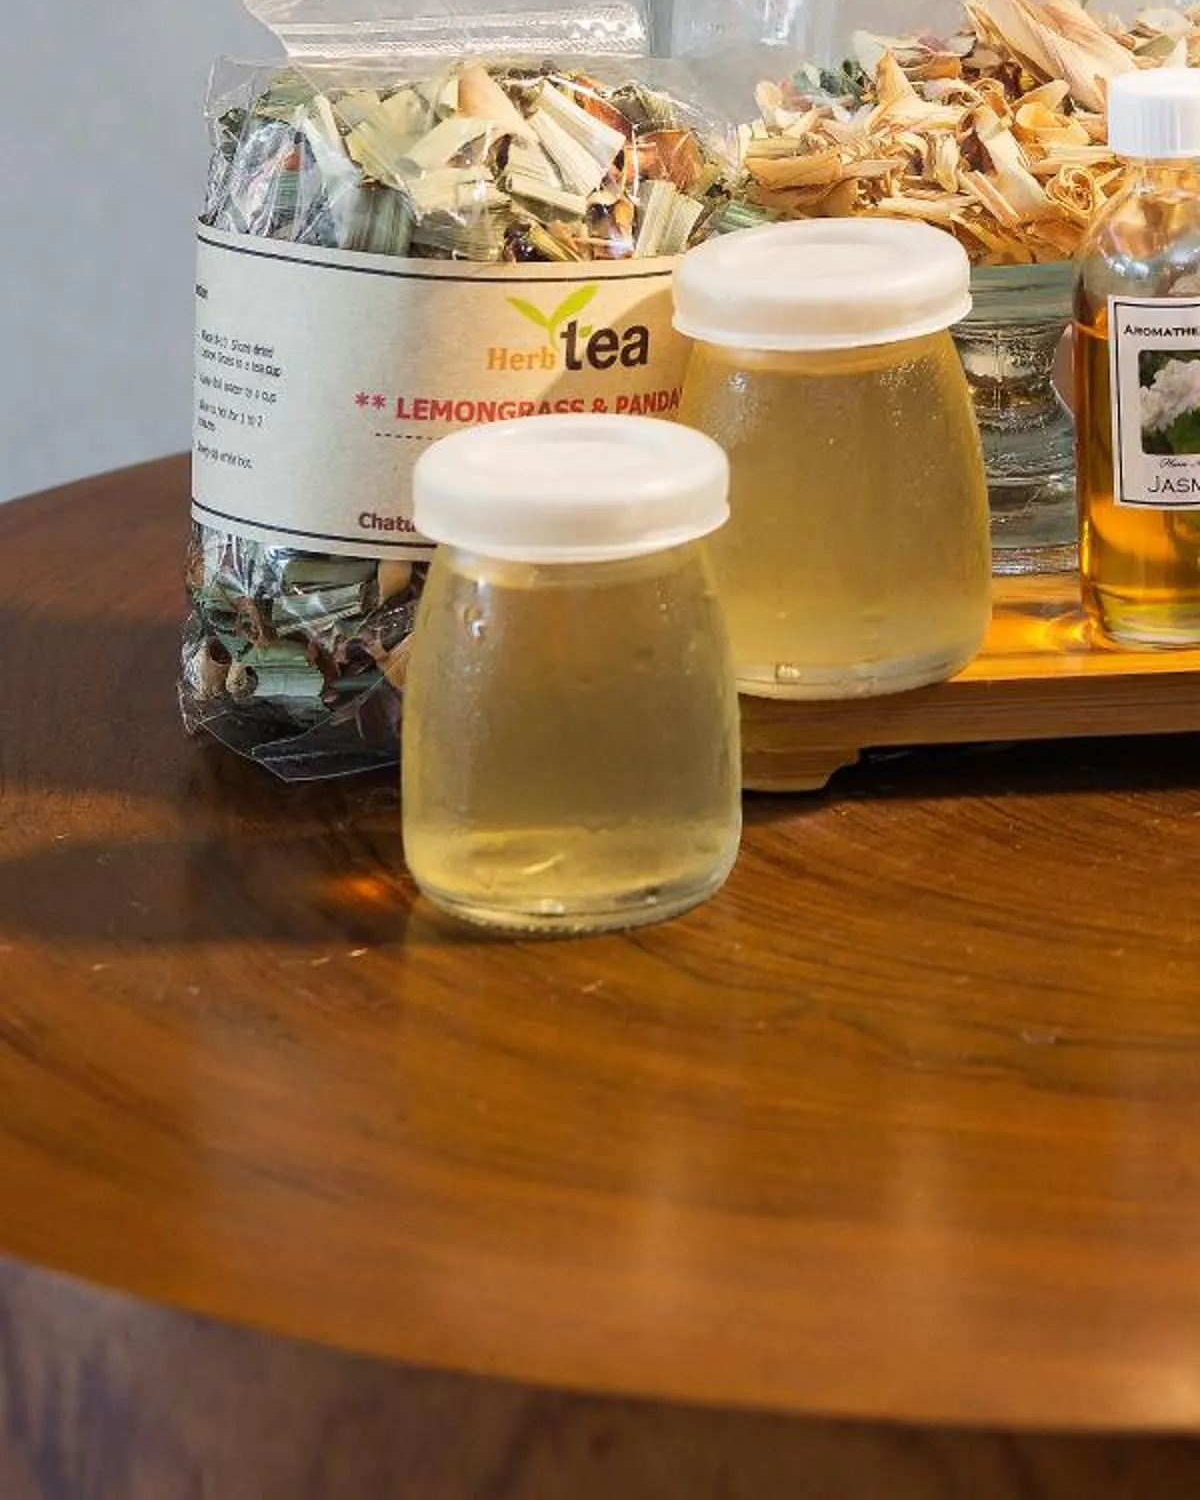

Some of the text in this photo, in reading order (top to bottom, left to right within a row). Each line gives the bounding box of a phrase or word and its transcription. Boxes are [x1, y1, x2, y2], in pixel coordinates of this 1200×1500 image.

[486, 319, 650, 371] Herb tea
[615, 387, 684, 415] PANDA
